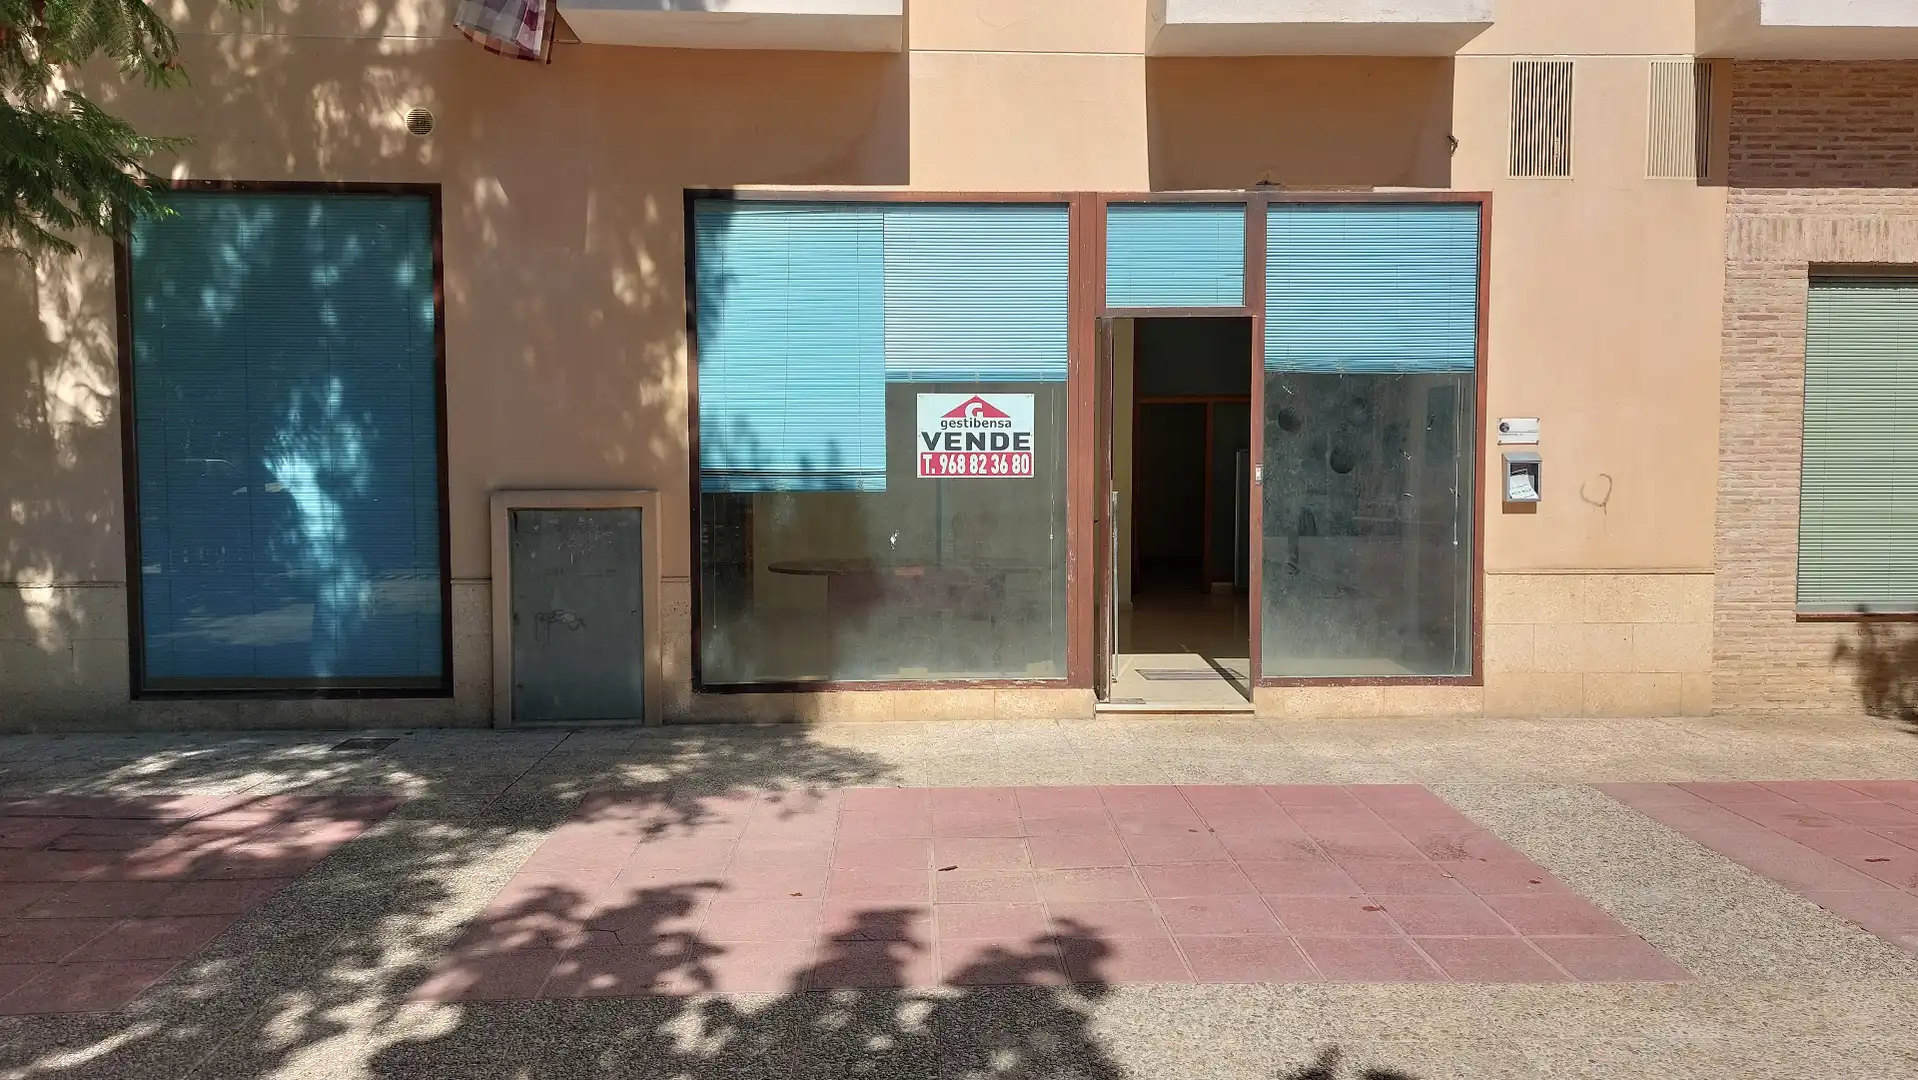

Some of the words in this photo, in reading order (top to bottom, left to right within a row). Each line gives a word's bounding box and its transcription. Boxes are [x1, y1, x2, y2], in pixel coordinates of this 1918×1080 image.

[940, 418, 1012, 430] gestibensa
[921, 432, 1031, 451] VENDE
[922, 454, 936, 475] T.
[939, 453, 966, 475] 968
[969, 453, 987, 475] 82
[991, 453, 1008, 475] 36
[1011, 453, 1030, 475] 80
